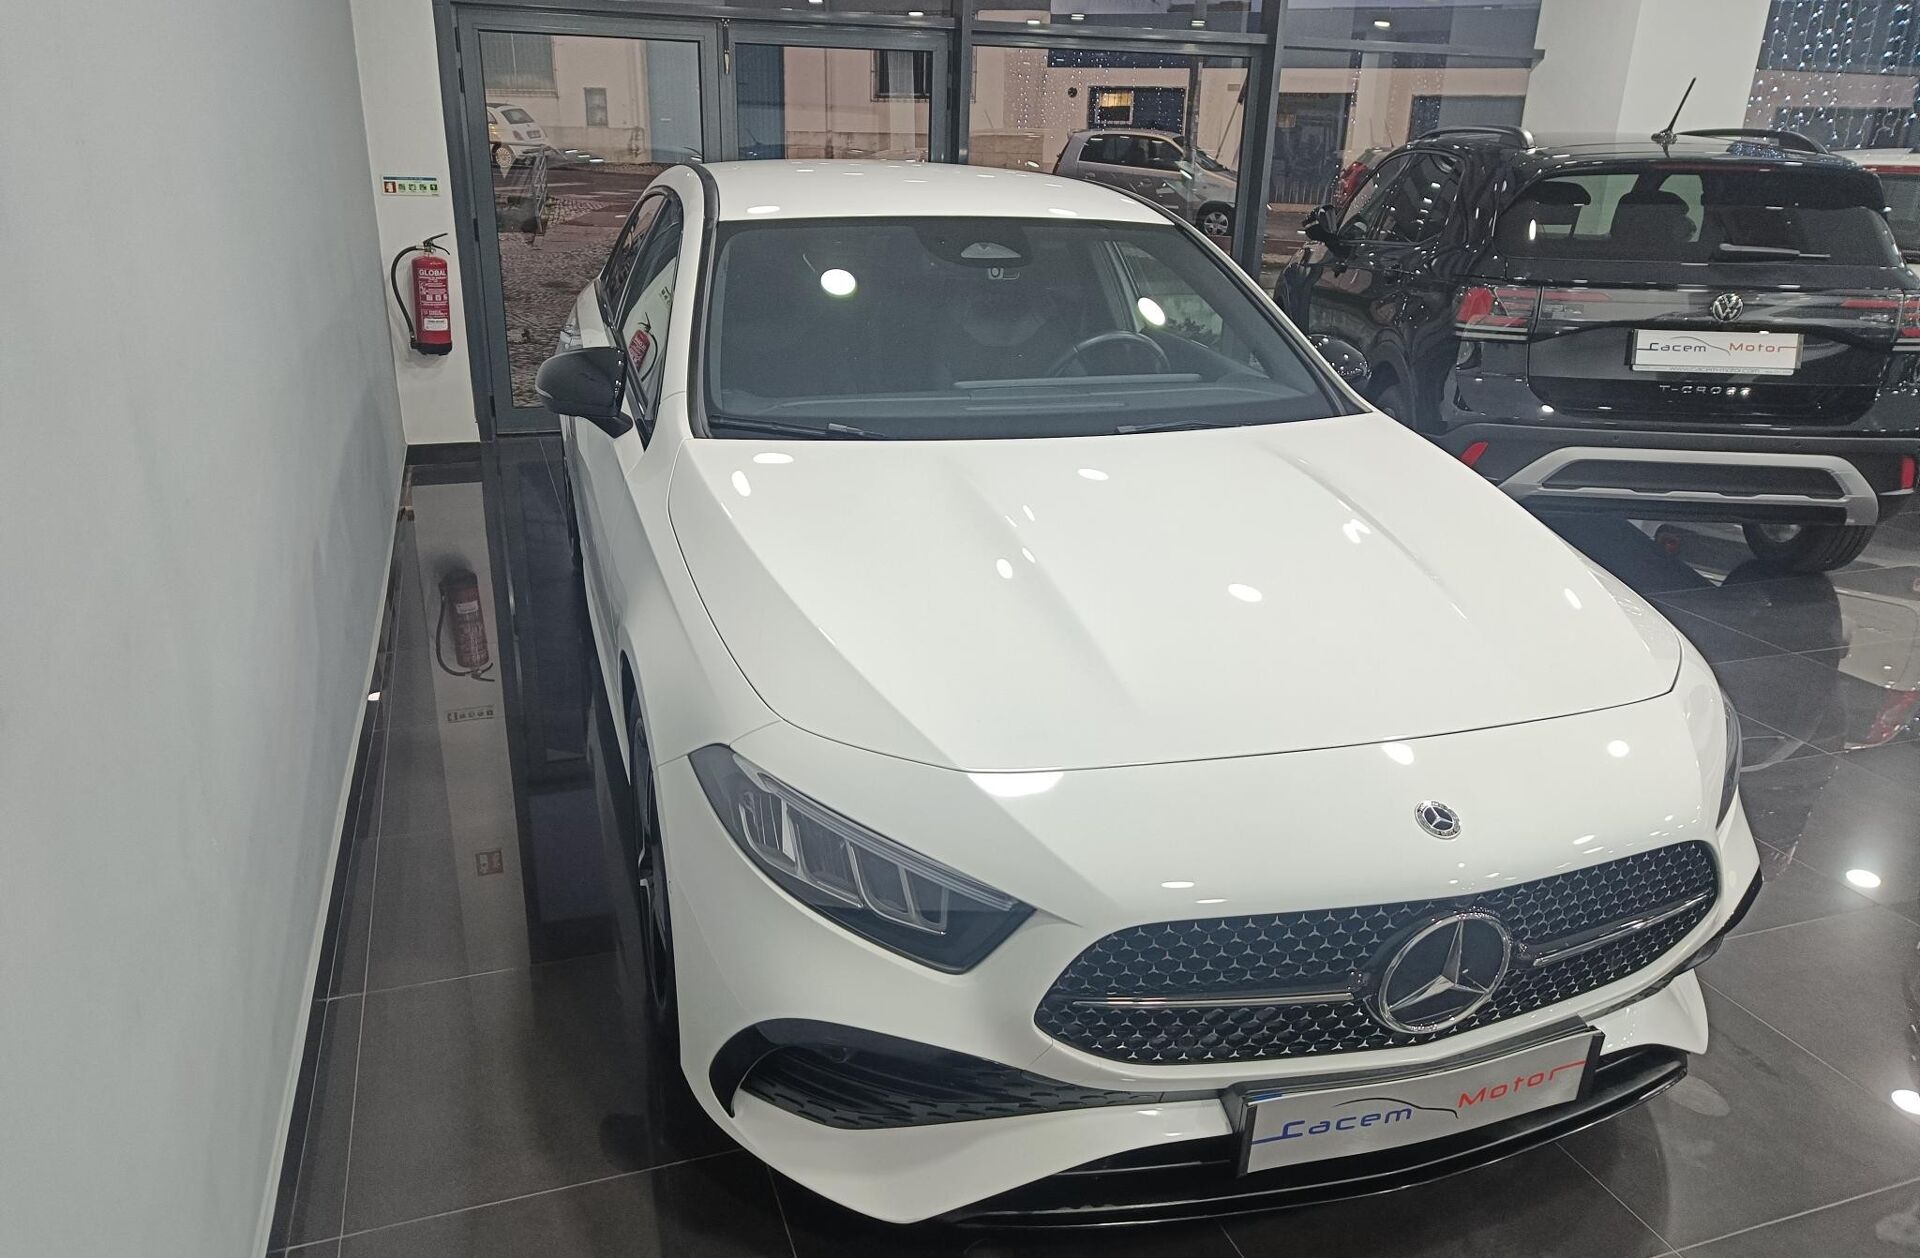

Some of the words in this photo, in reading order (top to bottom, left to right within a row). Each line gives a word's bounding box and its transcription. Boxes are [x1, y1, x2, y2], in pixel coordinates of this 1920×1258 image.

[1649, 342, 1706, 352] Cacem
[1729, 342, 1786, 353] Motor
[1281, 1107, 1412, 1140] Cacem
[1457, 1070, 1564, 1108] Motor
